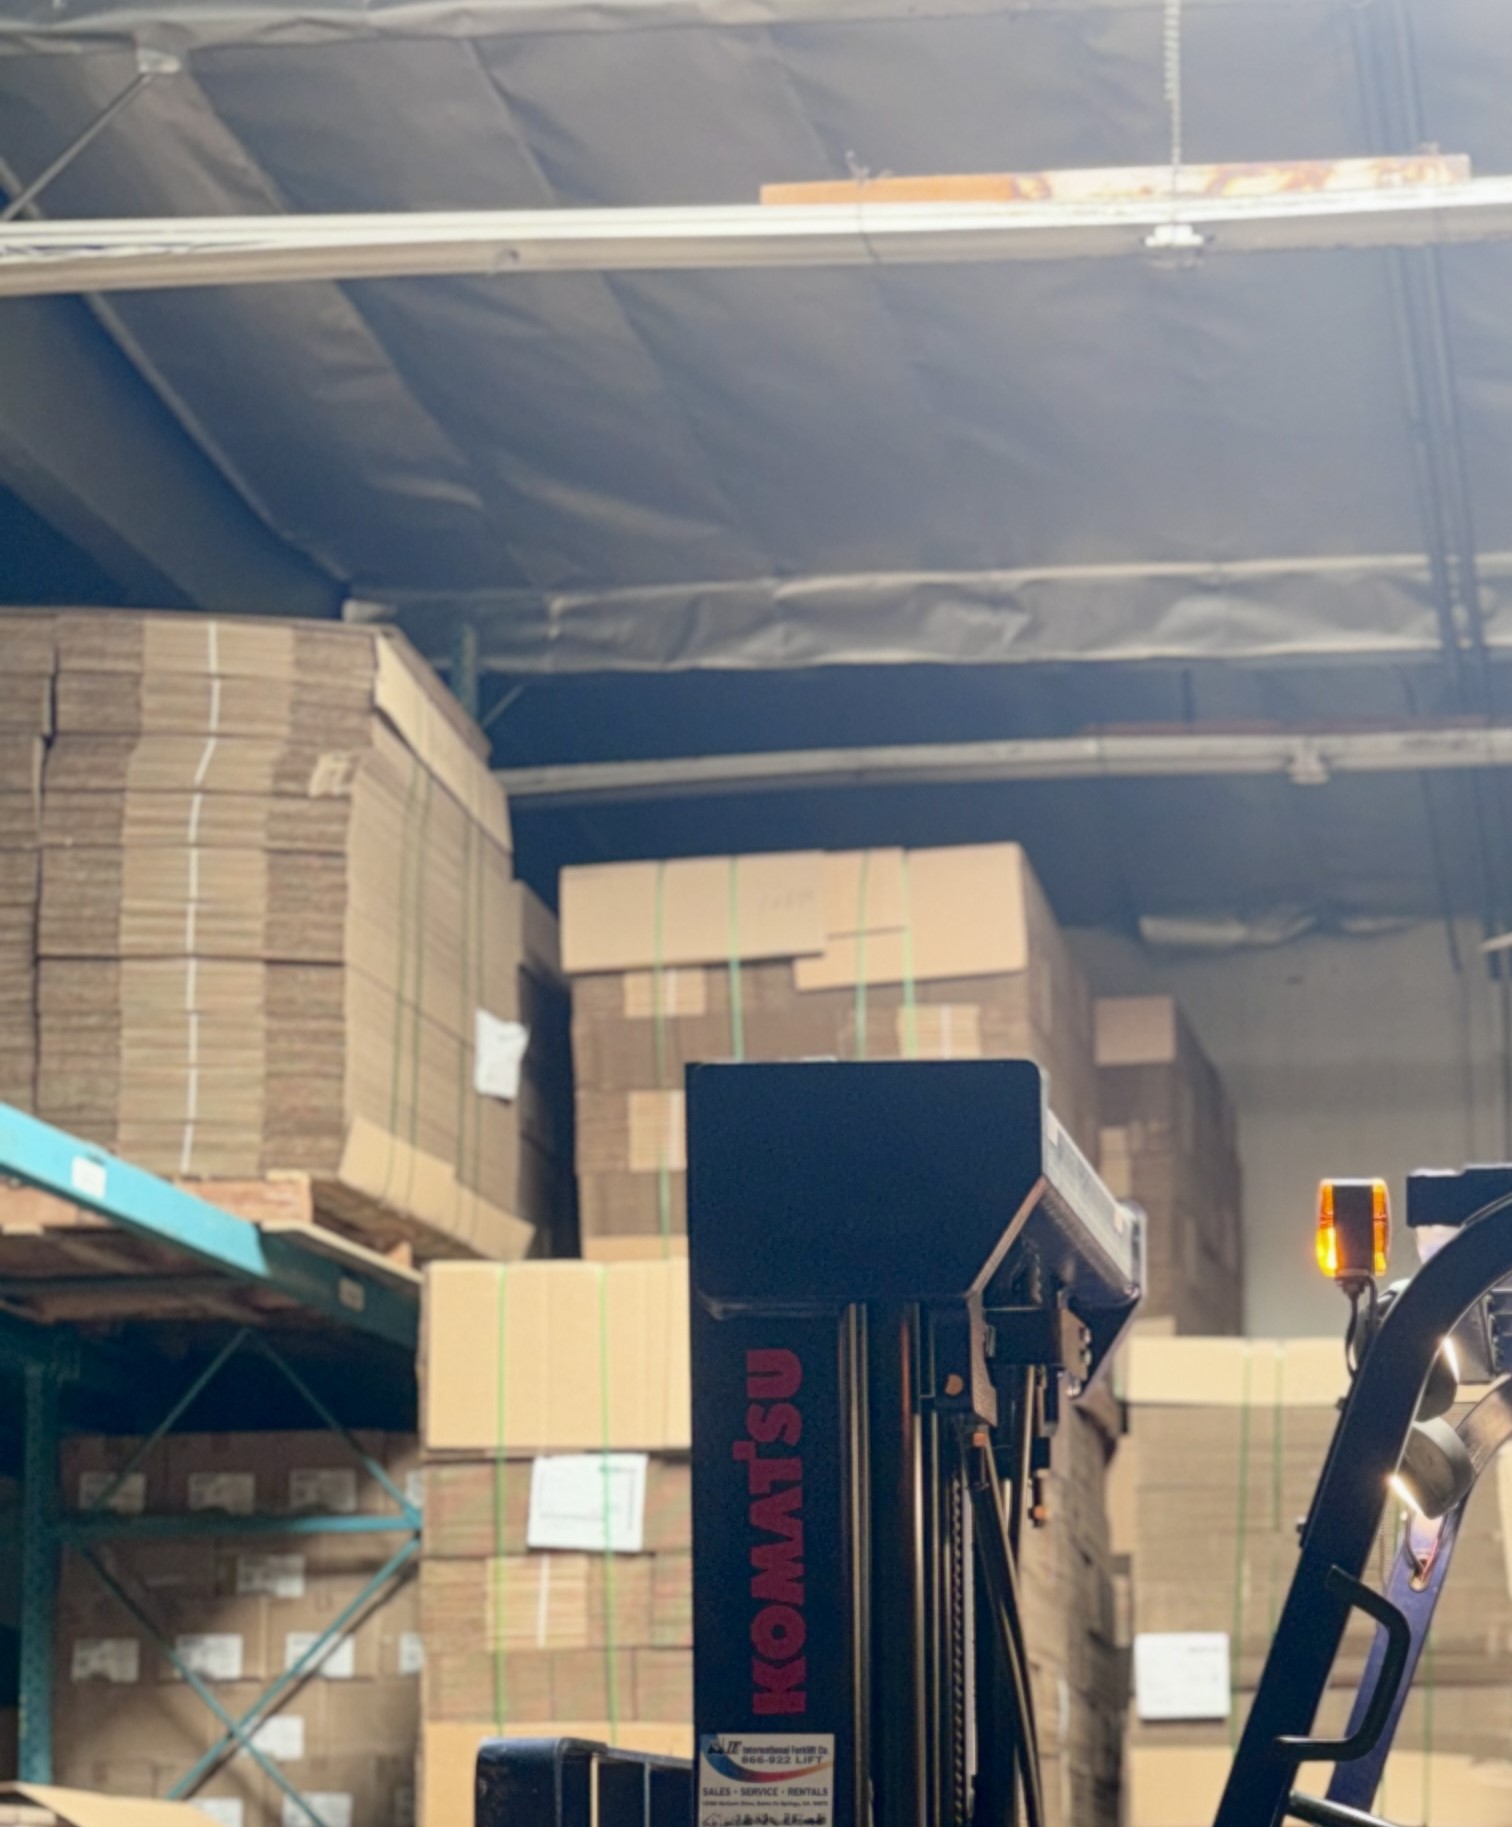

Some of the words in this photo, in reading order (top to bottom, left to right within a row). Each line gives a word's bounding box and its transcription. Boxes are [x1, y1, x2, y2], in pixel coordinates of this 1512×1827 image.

[732, 1348, 807, 1715] KOMATSU
[742, 1745, 790, 1755] International
[791, 1744, 817, 1755] Forklift
[795, 1755, 823, 1765] LIFT
[703, 1787, 731, 1797] SALES
[740, 1787, 779, 1797] SERVICE
[787, 1787, 829, 1797] RENTALS
